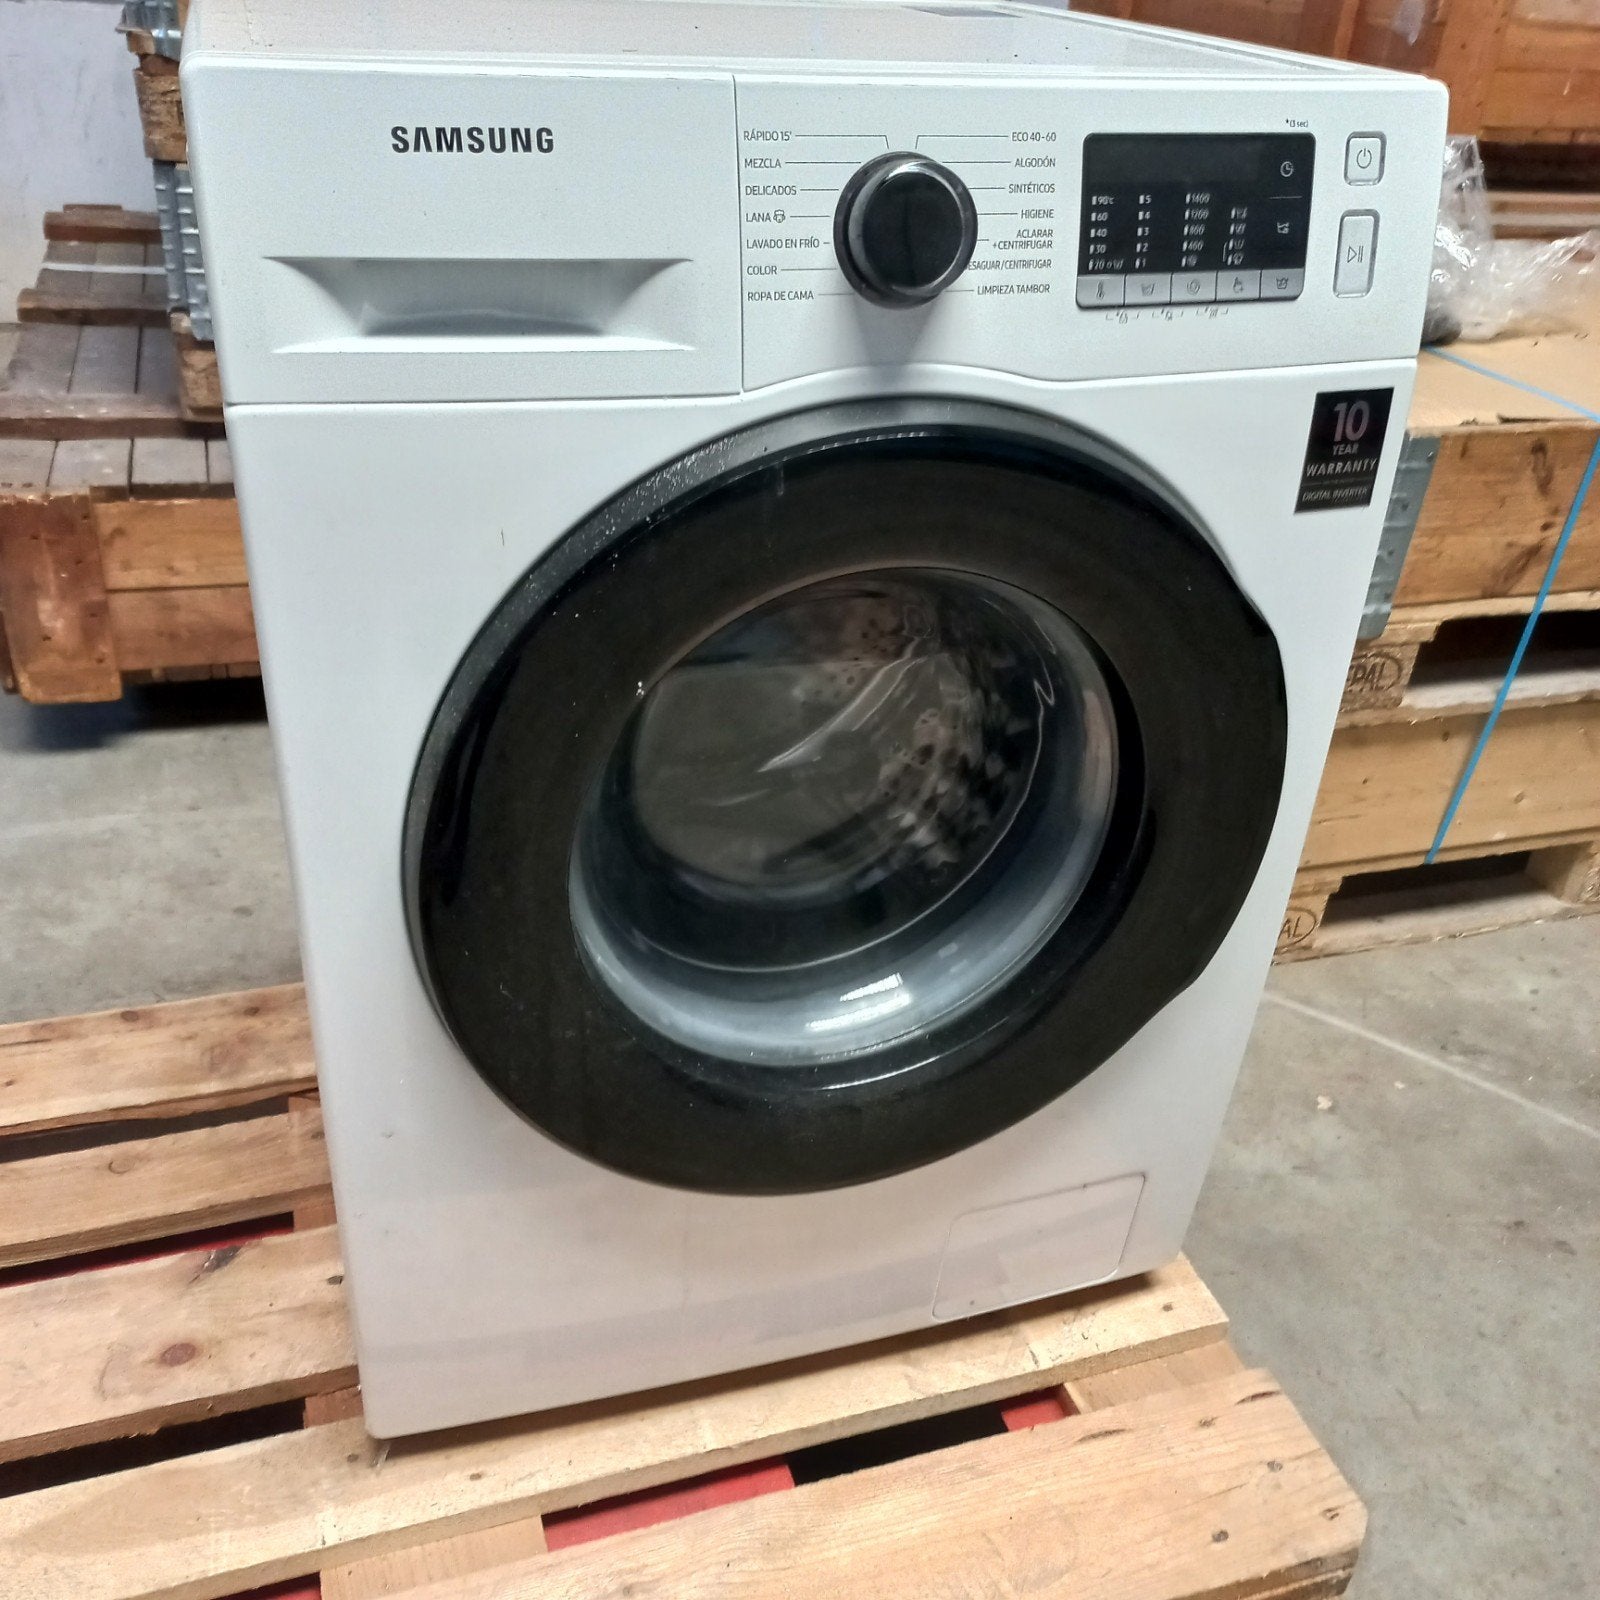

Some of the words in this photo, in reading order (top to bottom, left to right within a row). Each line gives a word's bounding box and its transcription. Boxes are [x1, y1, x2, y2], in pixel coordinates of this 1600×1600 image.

[391, 126, 554, 154] SAMSUNG
[743, 128, 779, 141] RÁPIDO
[1011, 131, 1029, 142] ECO
[1029, 131, 1057, 142] 40-60
[744, 158, 782, 169] MEZCLA
[1014, 155, 1056, 168] ALGODÓN
[745, 185, 797, 196] DELICADOS
[1008, 181, 1056, 194] SINTÉTICOS
[1145, 194, 1152, 205] 5
[745, 212, 772, 223] LANA
[1020, 208, 1055, 219] HIGIENE
[1096, 211, 1109, 222] 60
[1016, 228, 1054, 239] ACLARAR
[1096, 228, 1108, 238] 40
[1143, 227, 1150, 236] 3
[746, 238, 783, 249] LAVADO
[784, 238, 798, 249] EN
[799, 235, 820, 249] FRÍO
[992, 239, 1053, 250] +CENTRIFUGAR
[1142, 242, 1149, 252] 2
[967, 258, 1052, 271] ESAGUAR/CENTRIFUGAR
[746, 265, 778, 276] COLOR
[977, 284, 1015, 296] LIMPIEZA
[1016, 283, 1051, 295] TAMBOR
[747, 291, 773, 302] ROPA
[773, 290, 786, 301] DE
[786, 290, 815, 301] CAMA
[1333, 400, 1370, 442] 10
[1332, 443, 1360, 456] YEAR
[1306, 457, 1378, 478] WARRANTY
